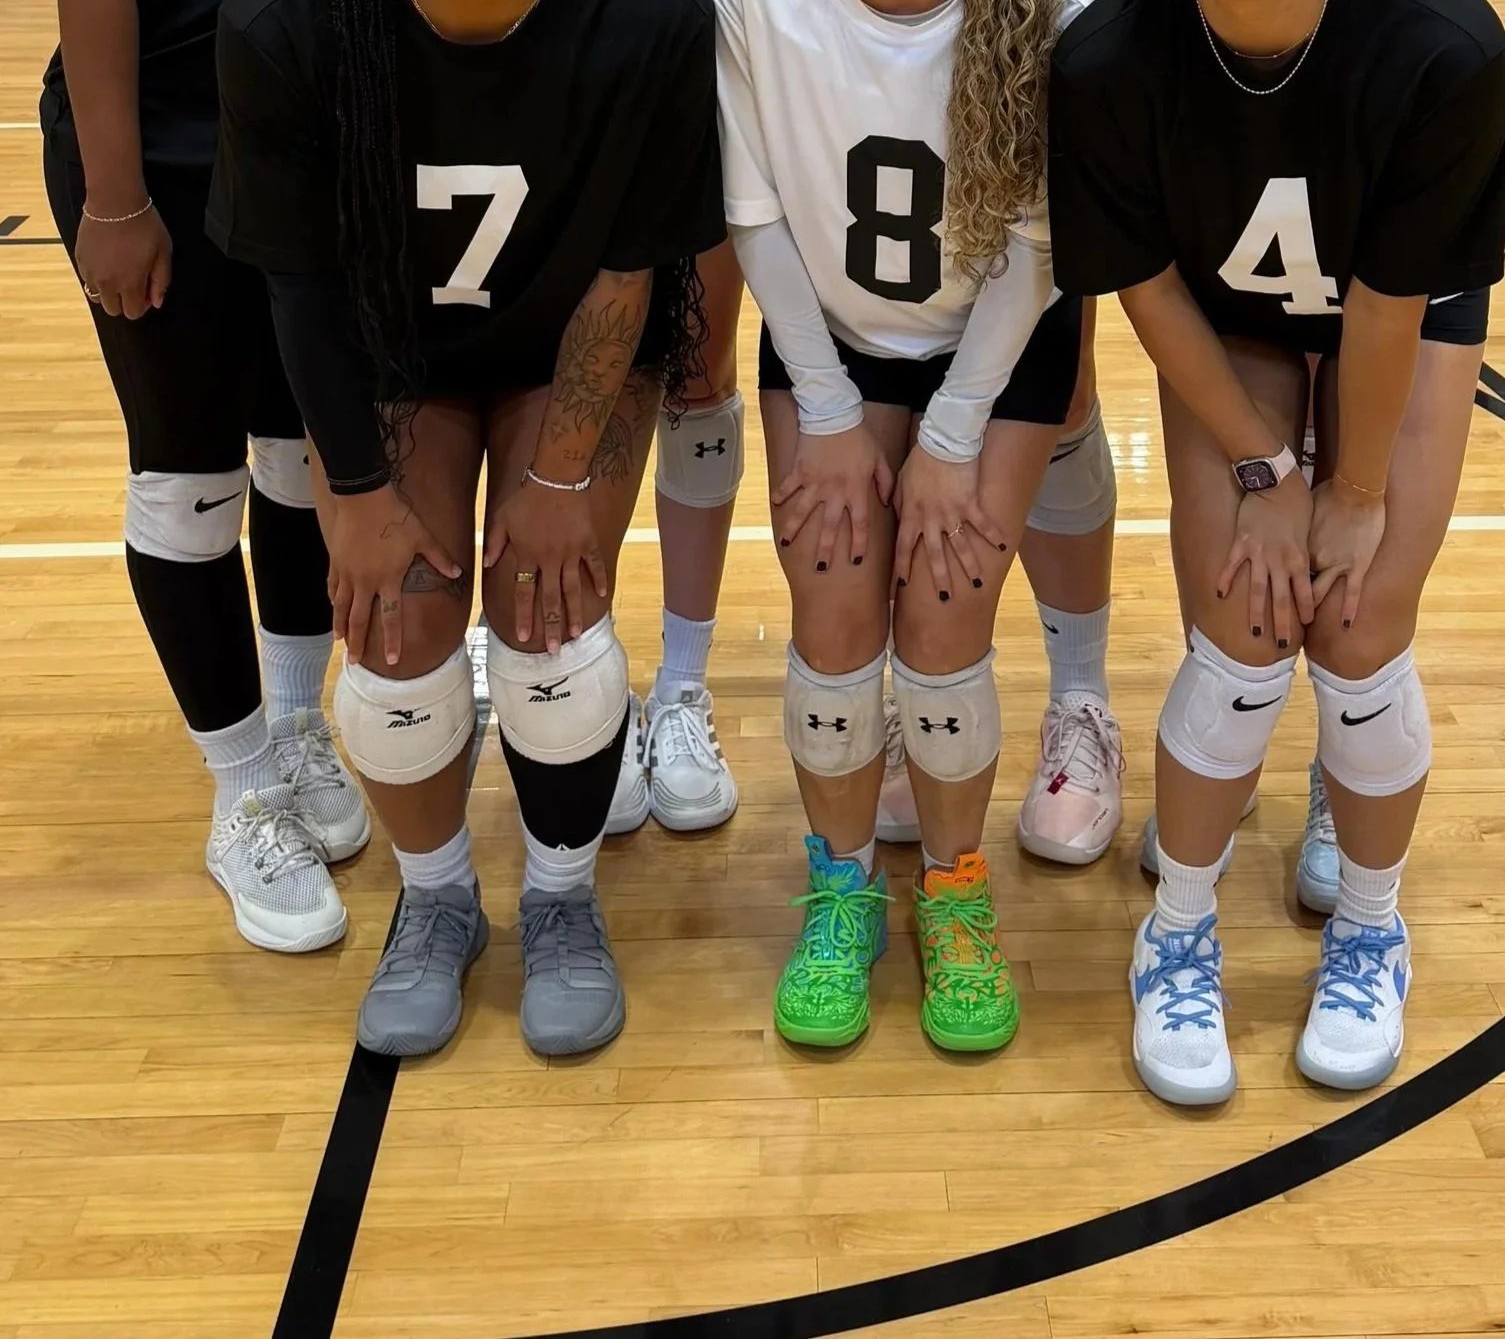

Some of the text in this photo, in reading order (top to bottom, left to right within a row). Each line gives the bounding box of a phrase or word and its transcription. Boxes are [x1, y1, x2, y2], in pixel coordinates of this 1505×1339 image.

[416, 164, 530, 309] 7
[846, 135, 945, 304] 8
[1217, 177, 1343, 315] 4
